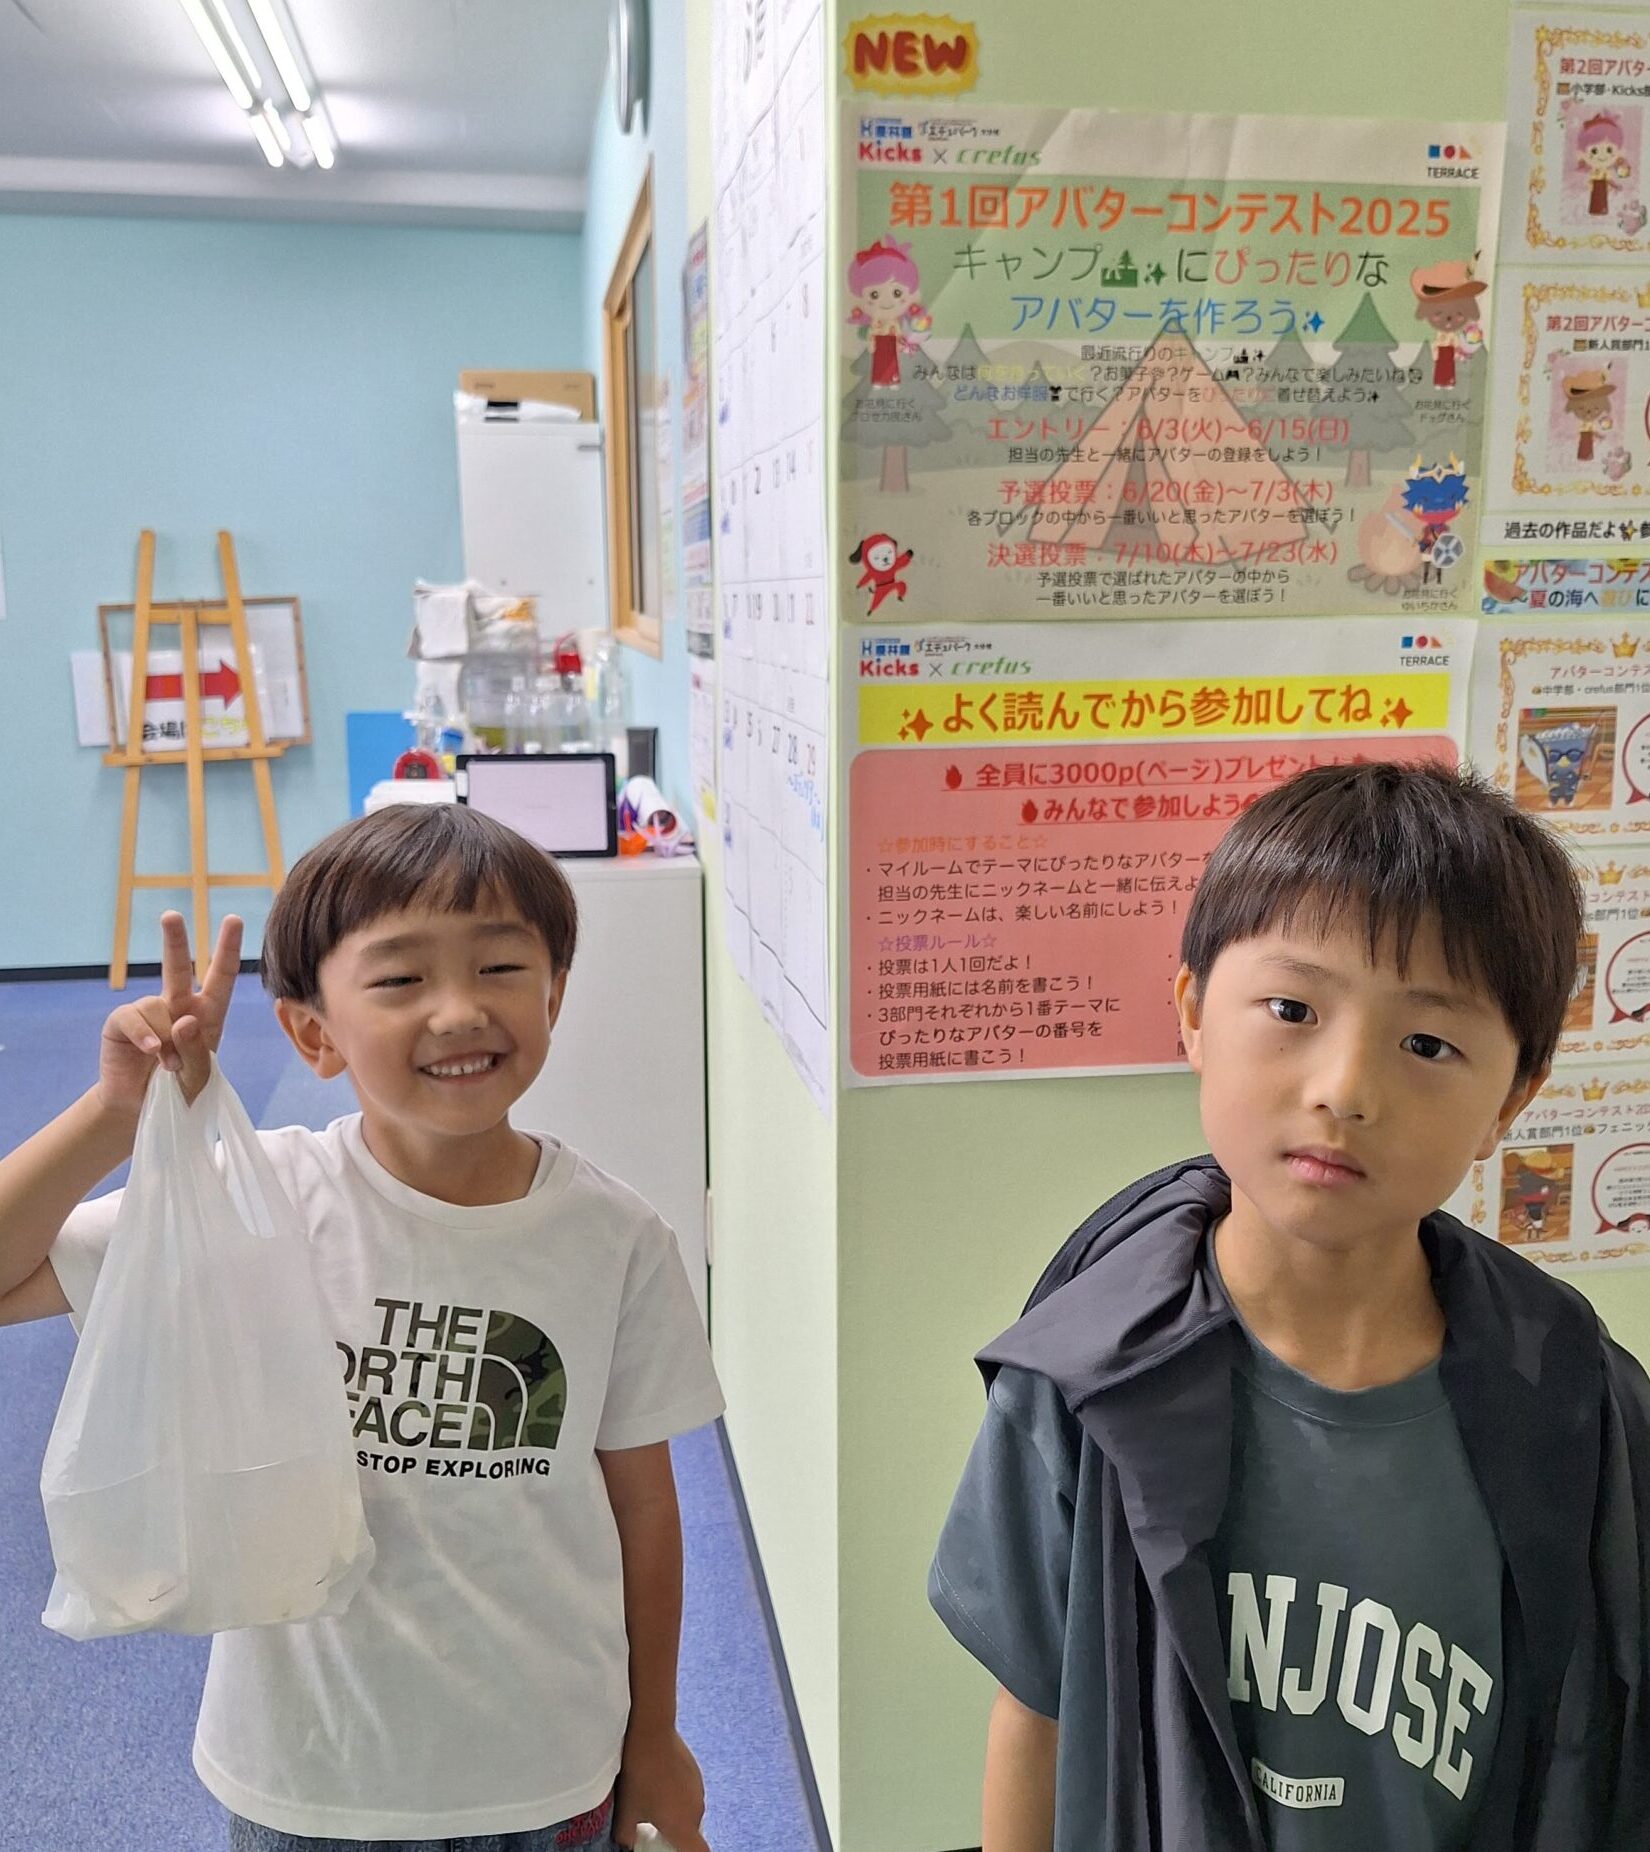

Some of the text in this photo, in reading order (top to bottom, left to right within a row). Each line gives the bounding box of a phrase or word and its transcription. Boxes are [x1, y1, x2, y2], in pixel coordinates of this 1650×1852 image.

[853, 30, 968, 76] NEW
[1560, 57, 1650, 77] 第2回アバタ
[859, 140, 922, 162] Kicks
[956, 143, 1042, 166] crefus
[1427, 166, 1480, 179] TERRACE
[889, 181, 1451, 238] 第1回アバターコンテスト2025
[954, 243, 1390, 288] キャンプ にぴったりな
[1011, 297, 1297, 335] アバターを作ろう
[1504, 520, 1616, 540] 過去の作品だよ
[860, 657, 919, 677] Kicks
[951, 655, 1032, 675] crefus
[1399, 655, 1450, 667] TERRACE
[942, 684, 1373, 733] よく読んでから参加してね
[1044, 793, 1241, 821] みんなで参加しよう
[878, 955, 1031, 977] 投票は1人1回だよ！
[878, 977, 1093, 1000] 投票用紙には名前を書こう！
[878, 998, 1121, 1023] 3部門それぞれから1番テーマに
[880, 1021, 1103, 1047] ぴったりなアバターの番号を
[878, 1049, 1025, 1071] 投票用紙に書こう！
[1598, 1122, 1650, 1134] フェニッ
[374, 1298, 484, 1354] THE
[356, 1450, 551, 1479] STOP EXPLORING
[1226, 1571, 1494, 1801] NJOSE
[1255, 1765, 1337, 1803] CALIFORNIA
